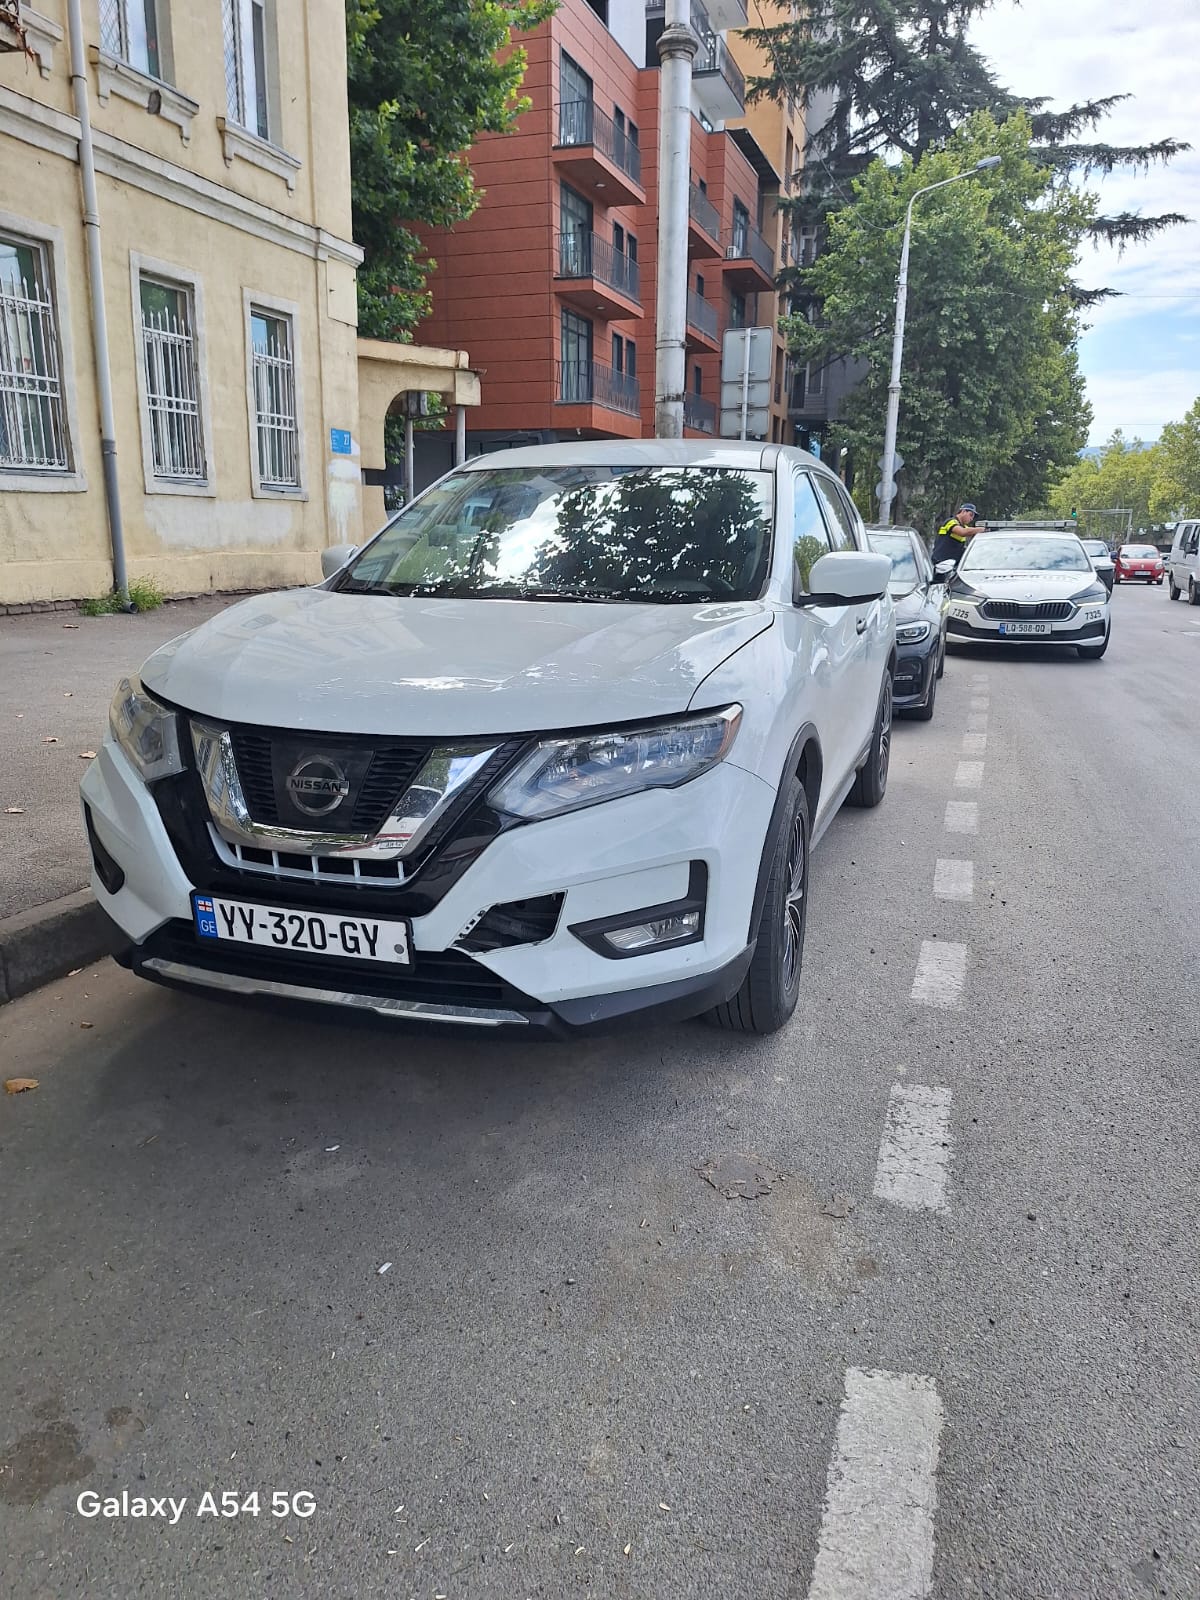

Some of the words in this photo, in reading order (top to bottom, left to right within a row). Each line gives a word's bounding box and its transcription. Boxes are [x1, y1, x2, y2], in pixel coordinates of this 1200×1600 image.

[952, 608, 969, 619] 7325
[1085, 610, 1102, 620] 7325
[291, 779, 340, 792] NISSAN
[201, 919, 216, 934] GE
[219, 904, 379, 957] YY-320-GY
